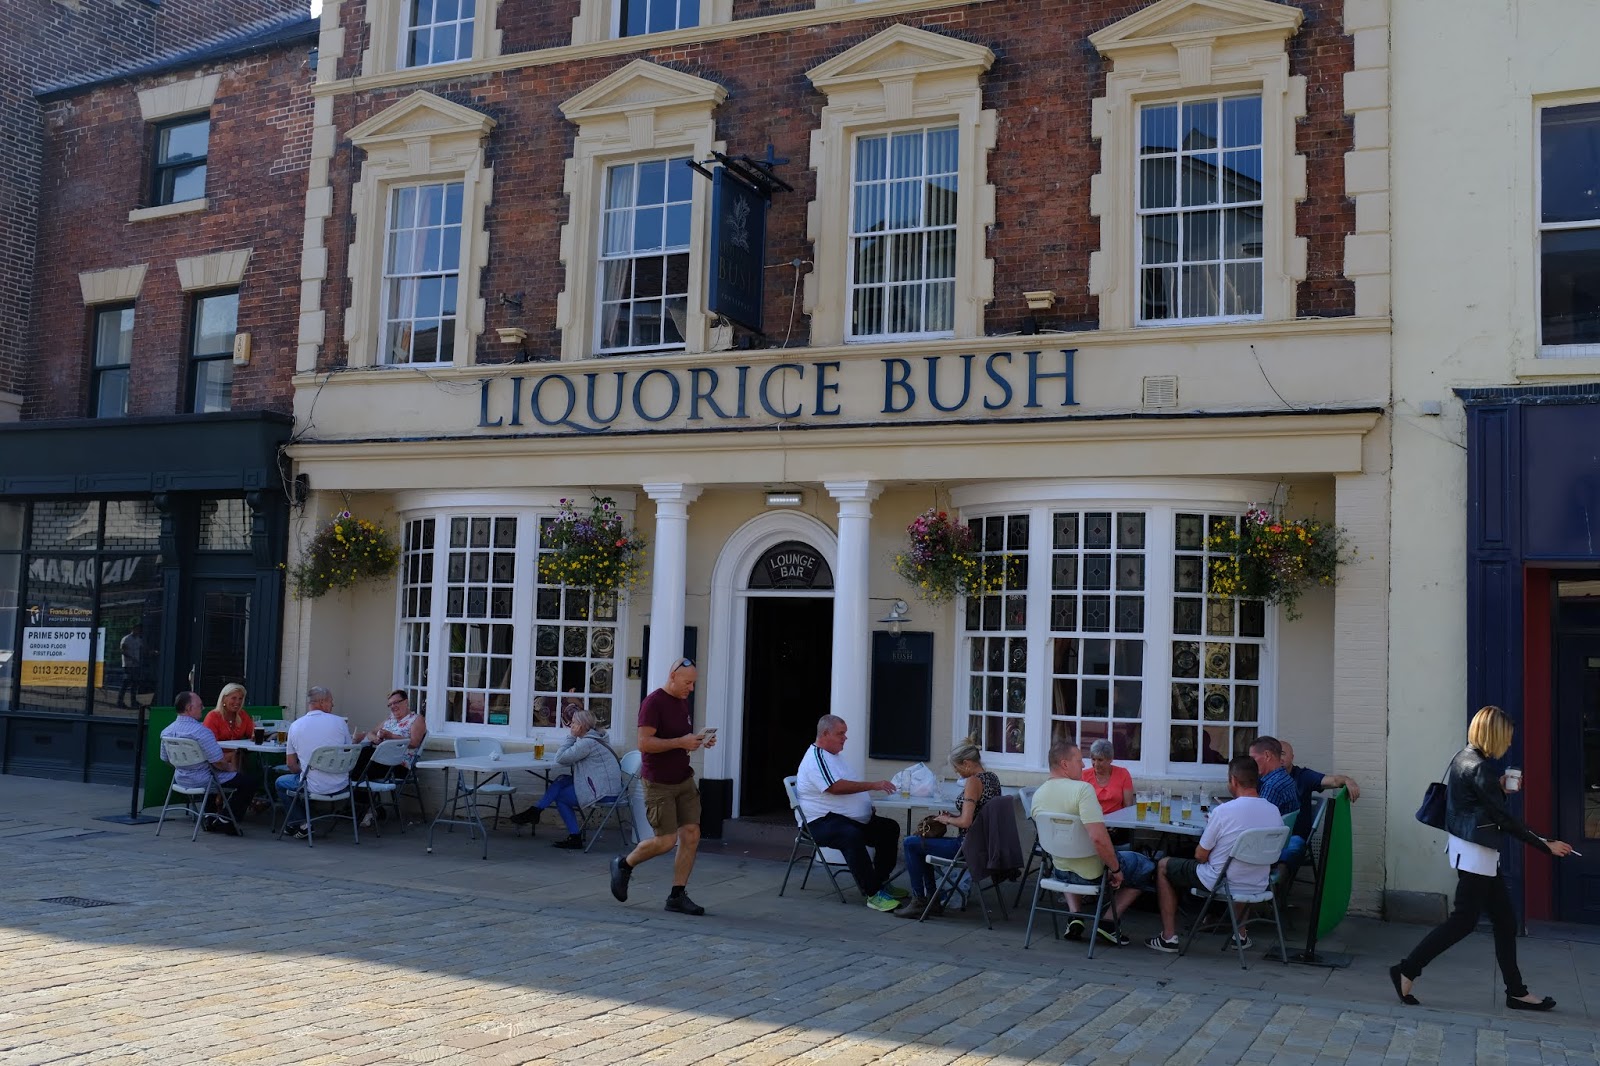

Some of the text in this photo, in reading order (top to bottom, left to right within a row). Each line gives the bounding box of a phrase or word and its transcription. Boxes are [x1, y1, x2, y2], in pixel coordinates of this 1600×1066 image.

[477, 348, 1081, 434] LIQUORICE BUSH
[770, 554, 816, 569] LOUNGE
[780, 566, 804, 578] BAR
[28, 631, 52, 640] PRIME
[54, 631, 75, 640] SHOP
[77, 631, 86, 640] TO
[32, 666, 51, 675] 0113
